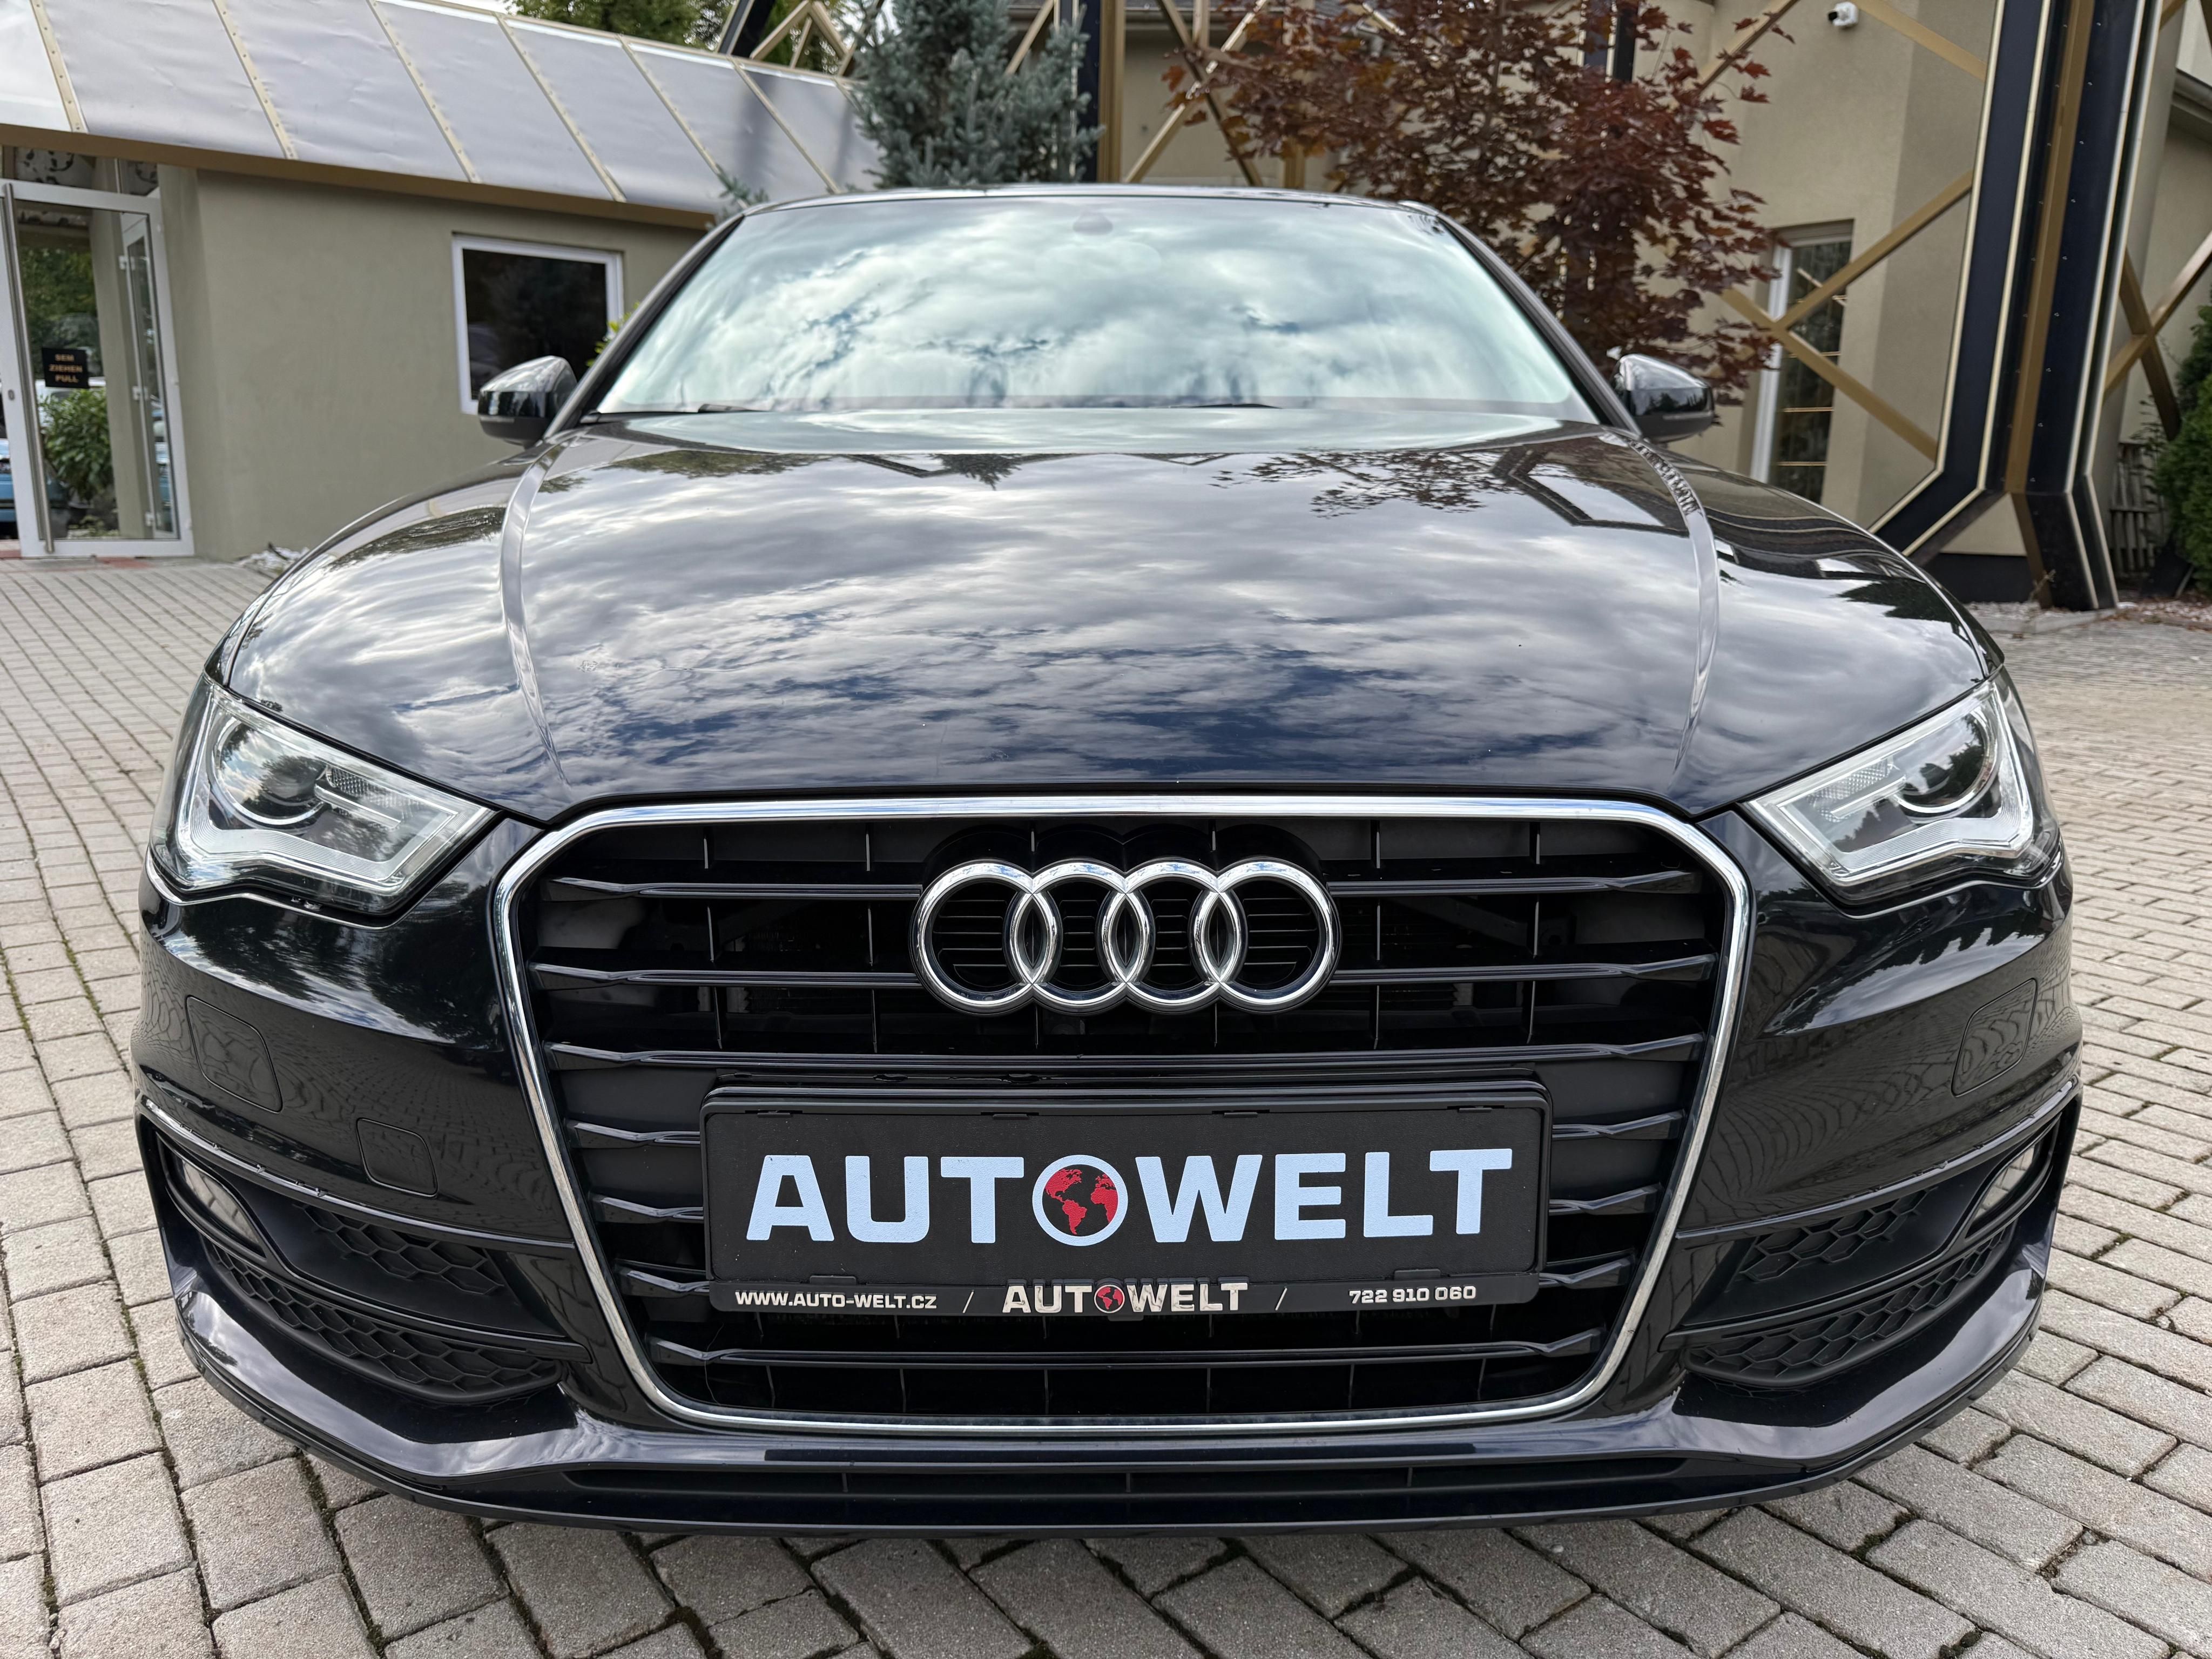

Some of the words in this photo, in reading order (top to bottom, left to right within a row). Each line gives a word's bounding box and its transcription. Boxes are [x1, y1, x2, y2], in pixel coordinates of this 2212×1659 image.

[55, 374, 78, 383] PULL
[746, 1148, 1513, 1246] AUTOWELT
[735, 1290, 938, 1309] WWW.AUTO-WELT.CZ
[1002, 1280, 1249, 1313] AUTOWELT
[1349, 1289, 1387, 1304] 722
[1392, 1287, 1429, 1303] 910
[1434, 1285, 1476, 1300] 060
